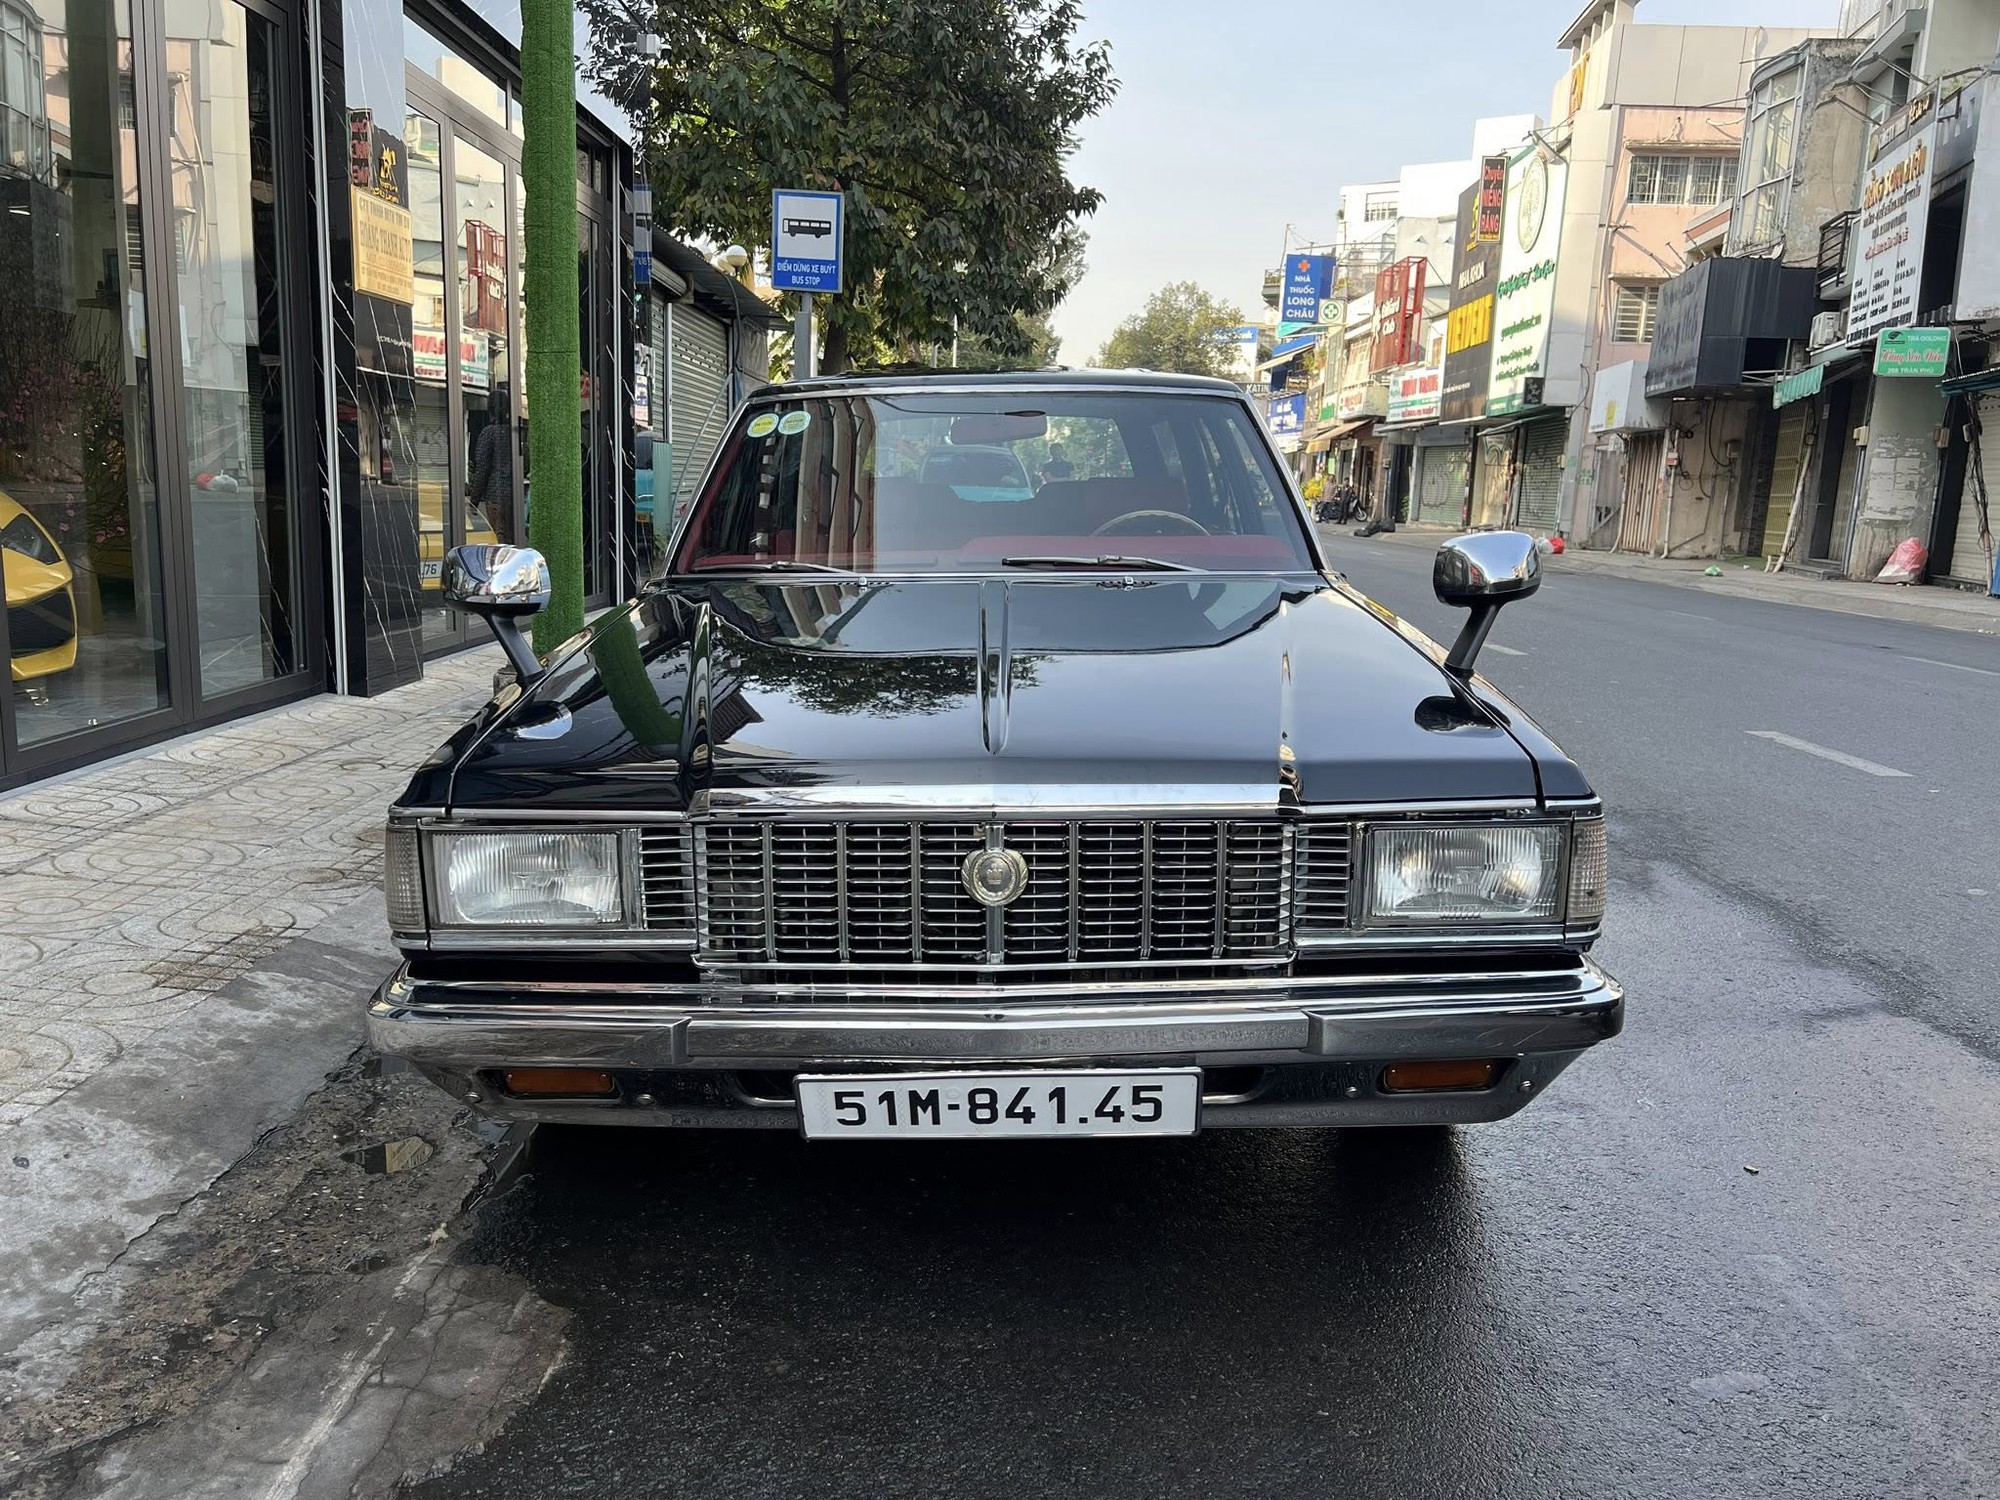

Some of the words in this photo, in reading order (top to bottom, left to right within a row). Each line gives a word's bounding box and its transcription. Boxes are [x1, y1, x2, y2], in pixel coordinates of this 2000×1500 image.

[811, 264, 819, 273] XE
[792, 276, 804, 284] BUS
[805, 276, 821, 285] STOP
[1294, 274, 1311, 282] NHÀ
[1290, 285, 1315, 294] THUỐC
[1287, 297, 1315, 306] LONG
[1286, 308, 1315, 319] CHÂU
[835, 1085, 1164, 1126] 51M-841.45
